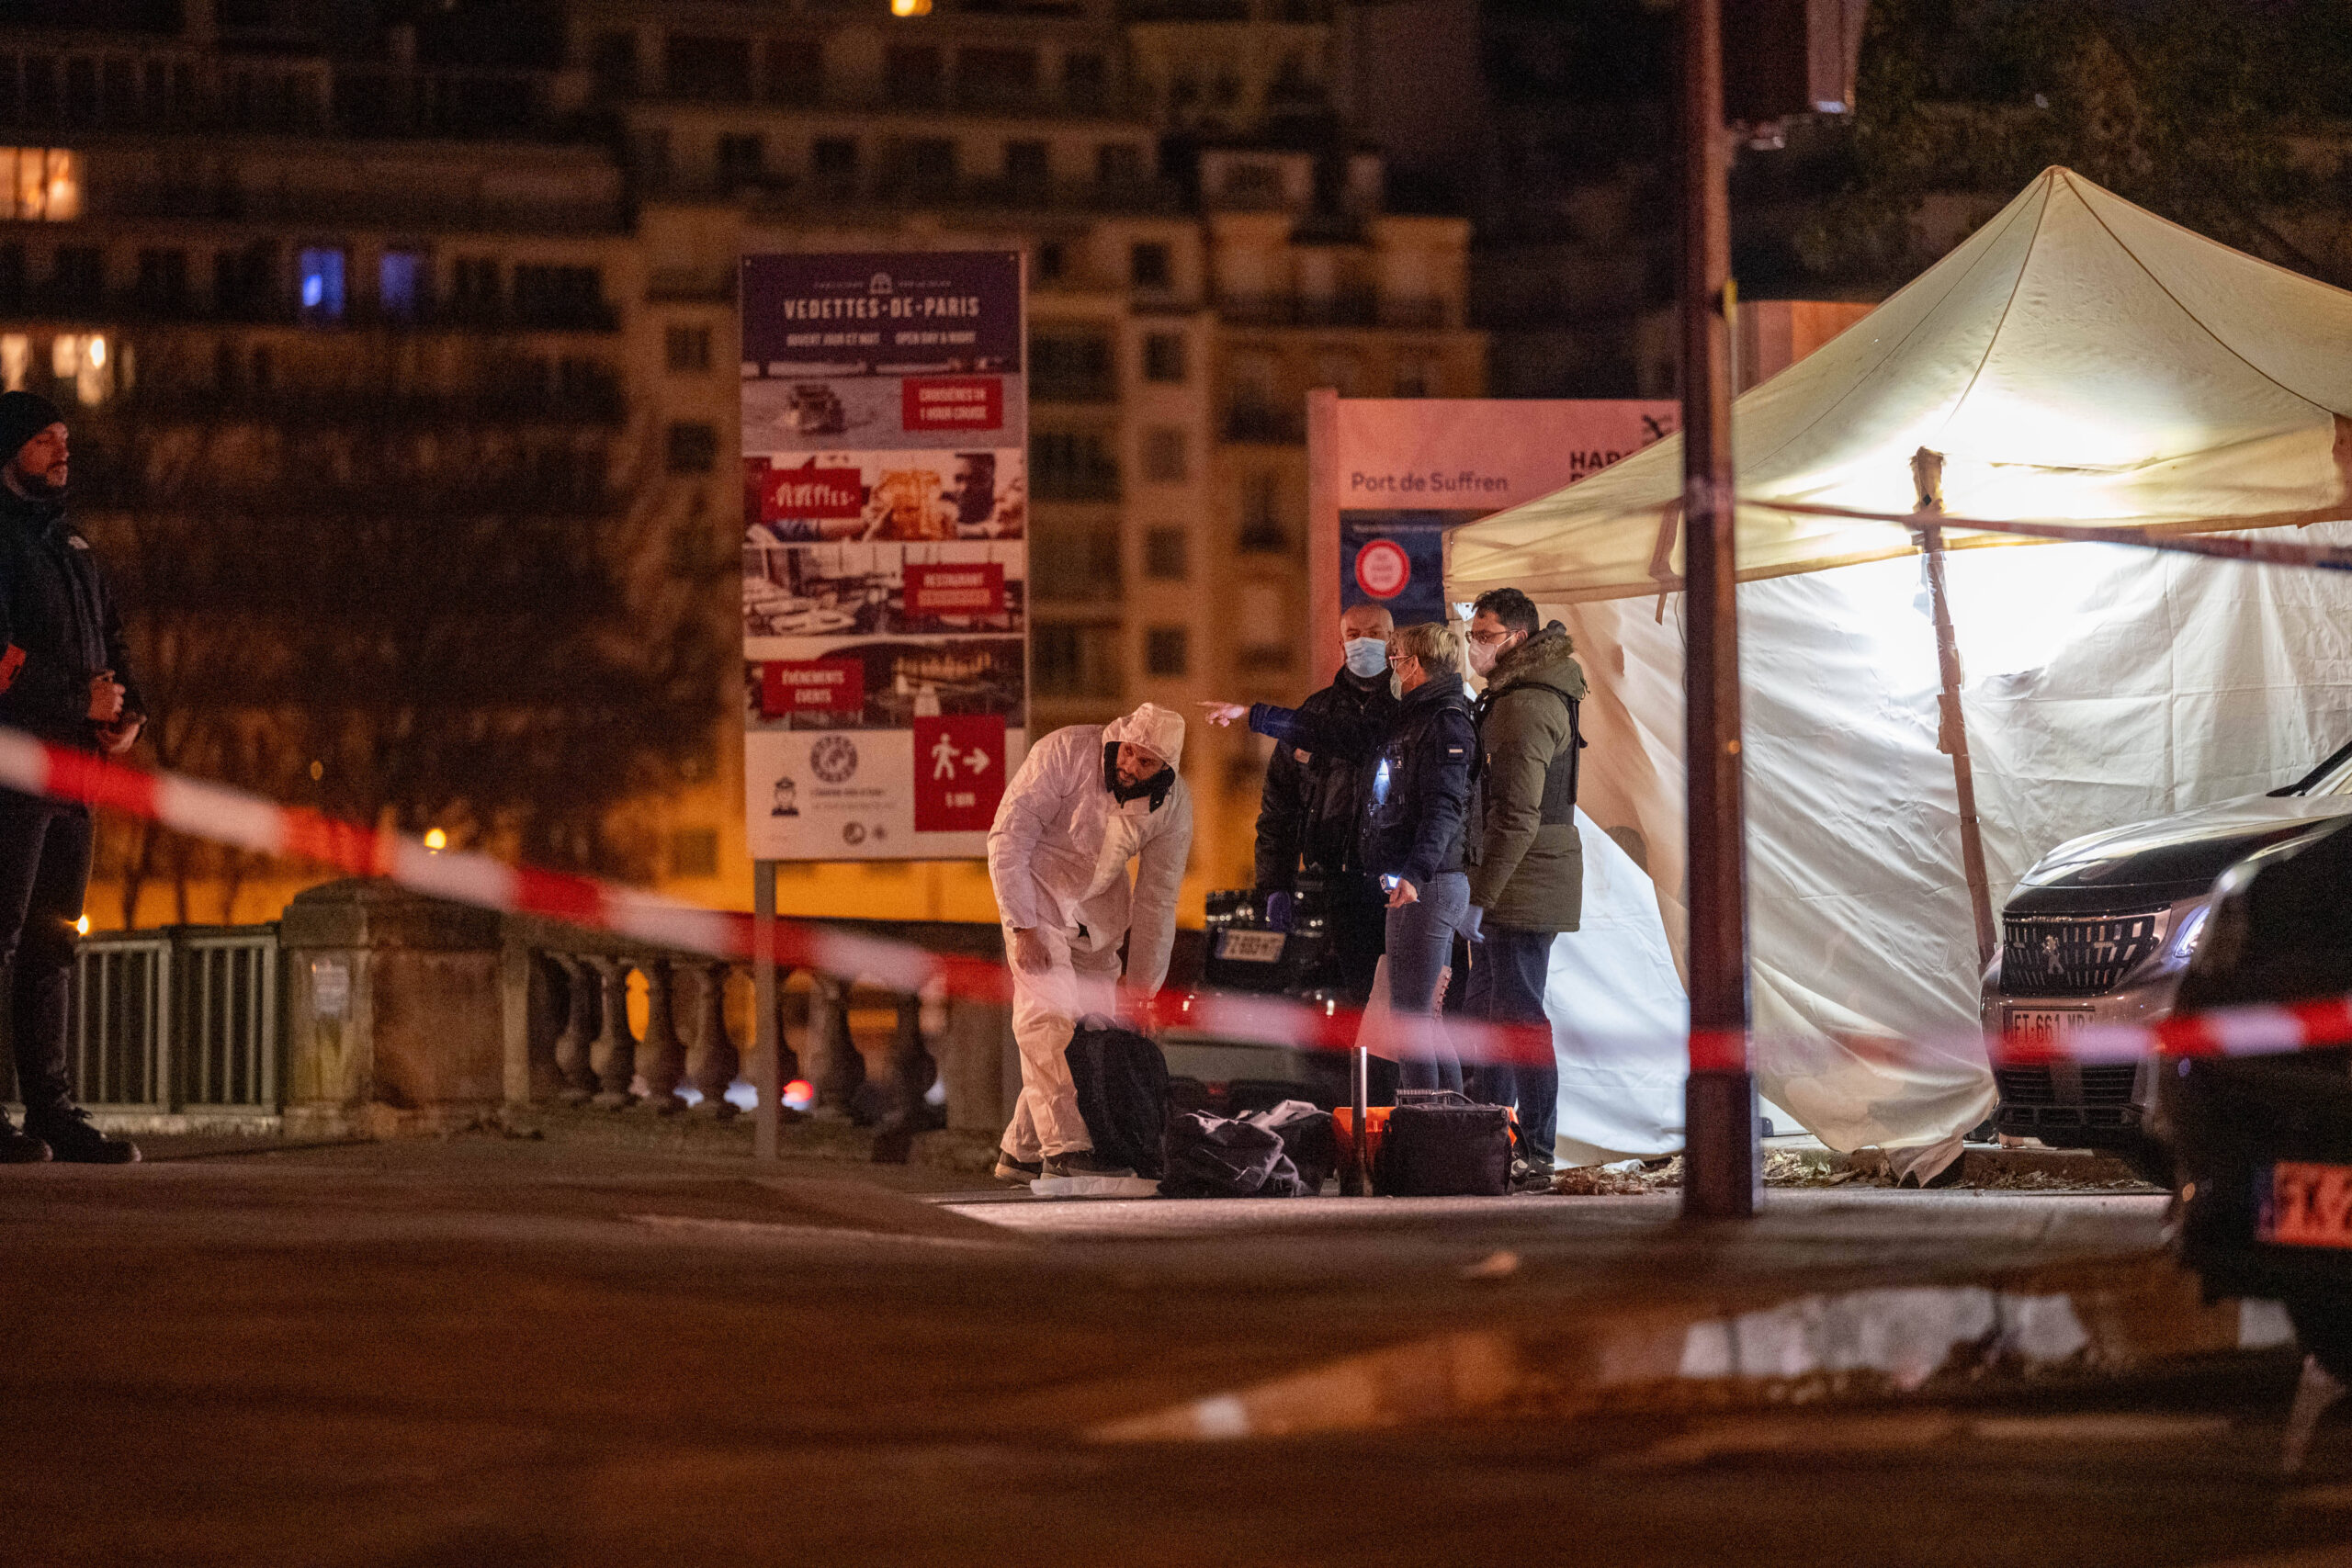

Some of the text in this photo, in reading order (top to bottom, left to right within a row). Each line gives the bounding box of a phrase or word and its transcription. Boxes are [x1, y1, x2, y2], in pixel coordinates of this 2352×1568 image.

[924, 296, 979, 318] PARIS
[1570, 451, 1633, 469] HAR
[1351, 471, 1508, 491] Port de Suffren
